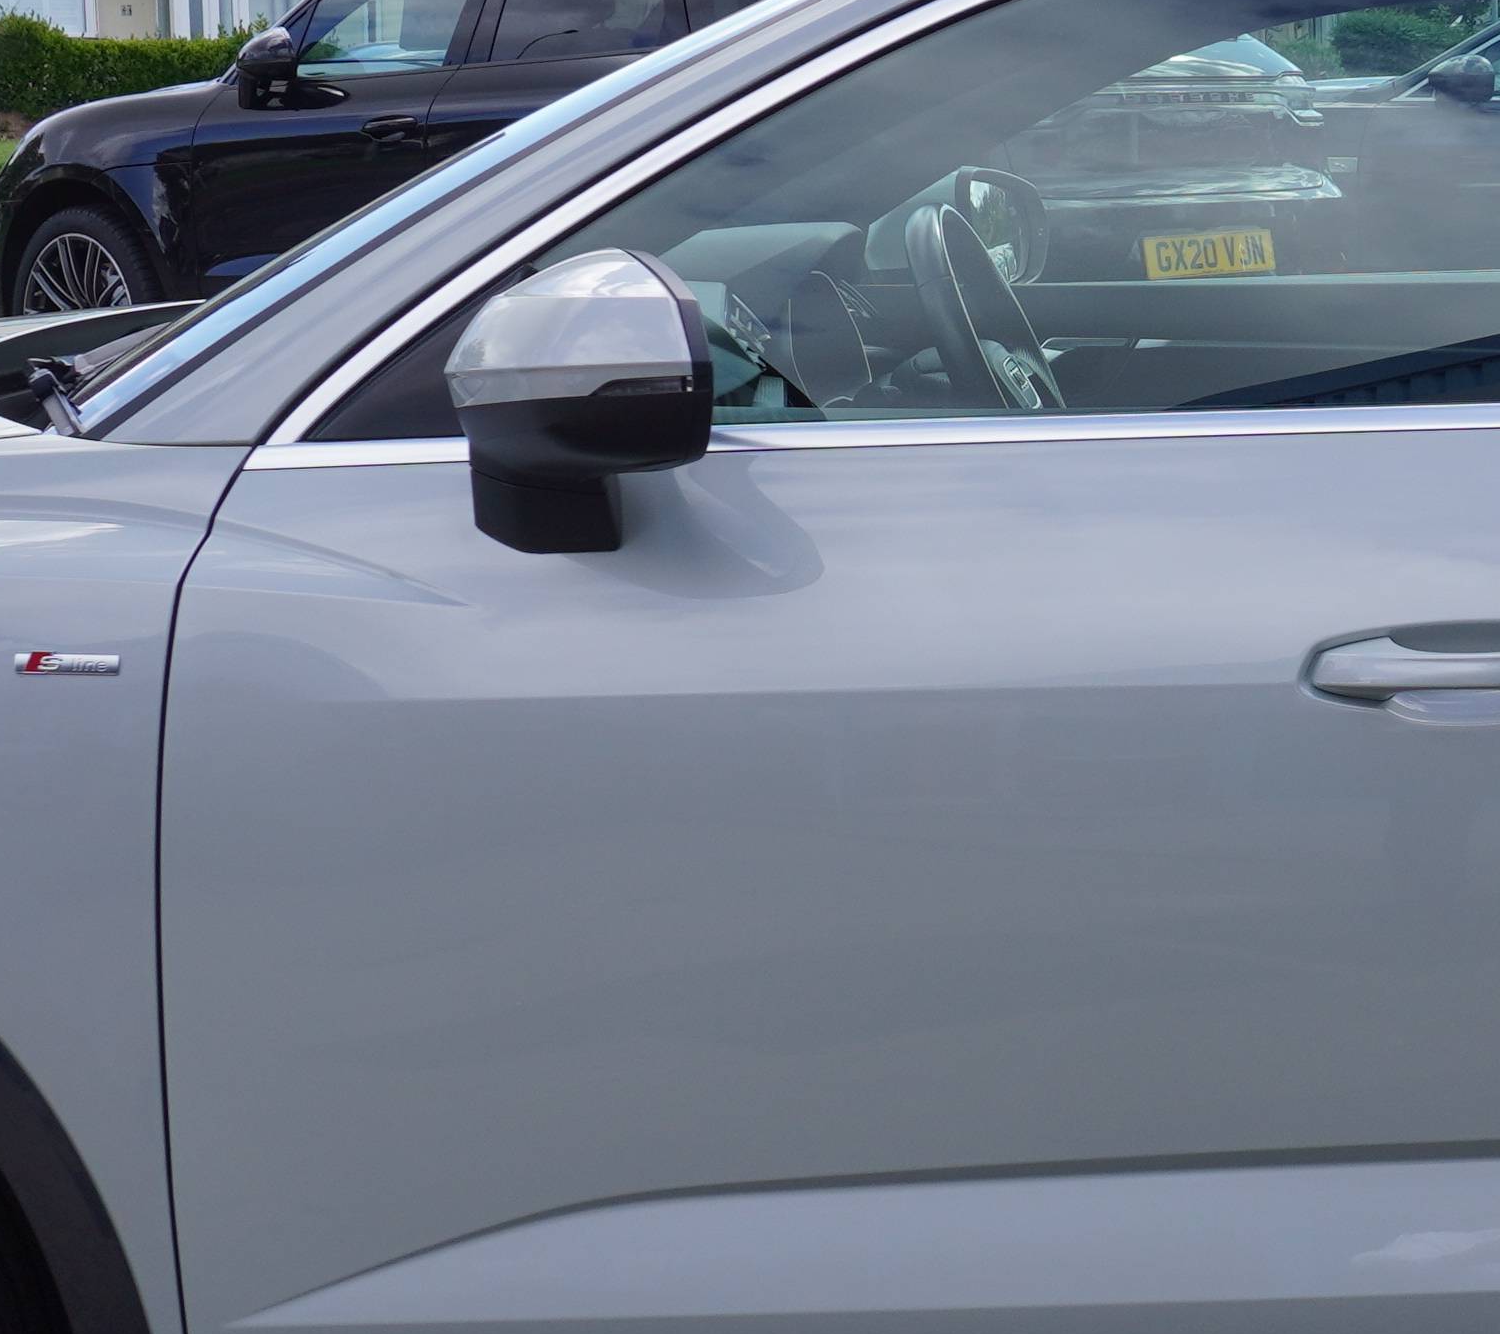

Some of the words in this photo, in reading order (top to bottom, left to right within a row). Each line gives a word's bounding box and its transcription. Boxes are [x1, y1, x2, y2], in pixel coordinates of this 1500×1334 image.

[1155, 239, 1217, 273] GX20
[1224, 234, 1266, 267] VJN
[37, 655, 63, 671] S
[70, 658, 108, 672] line
